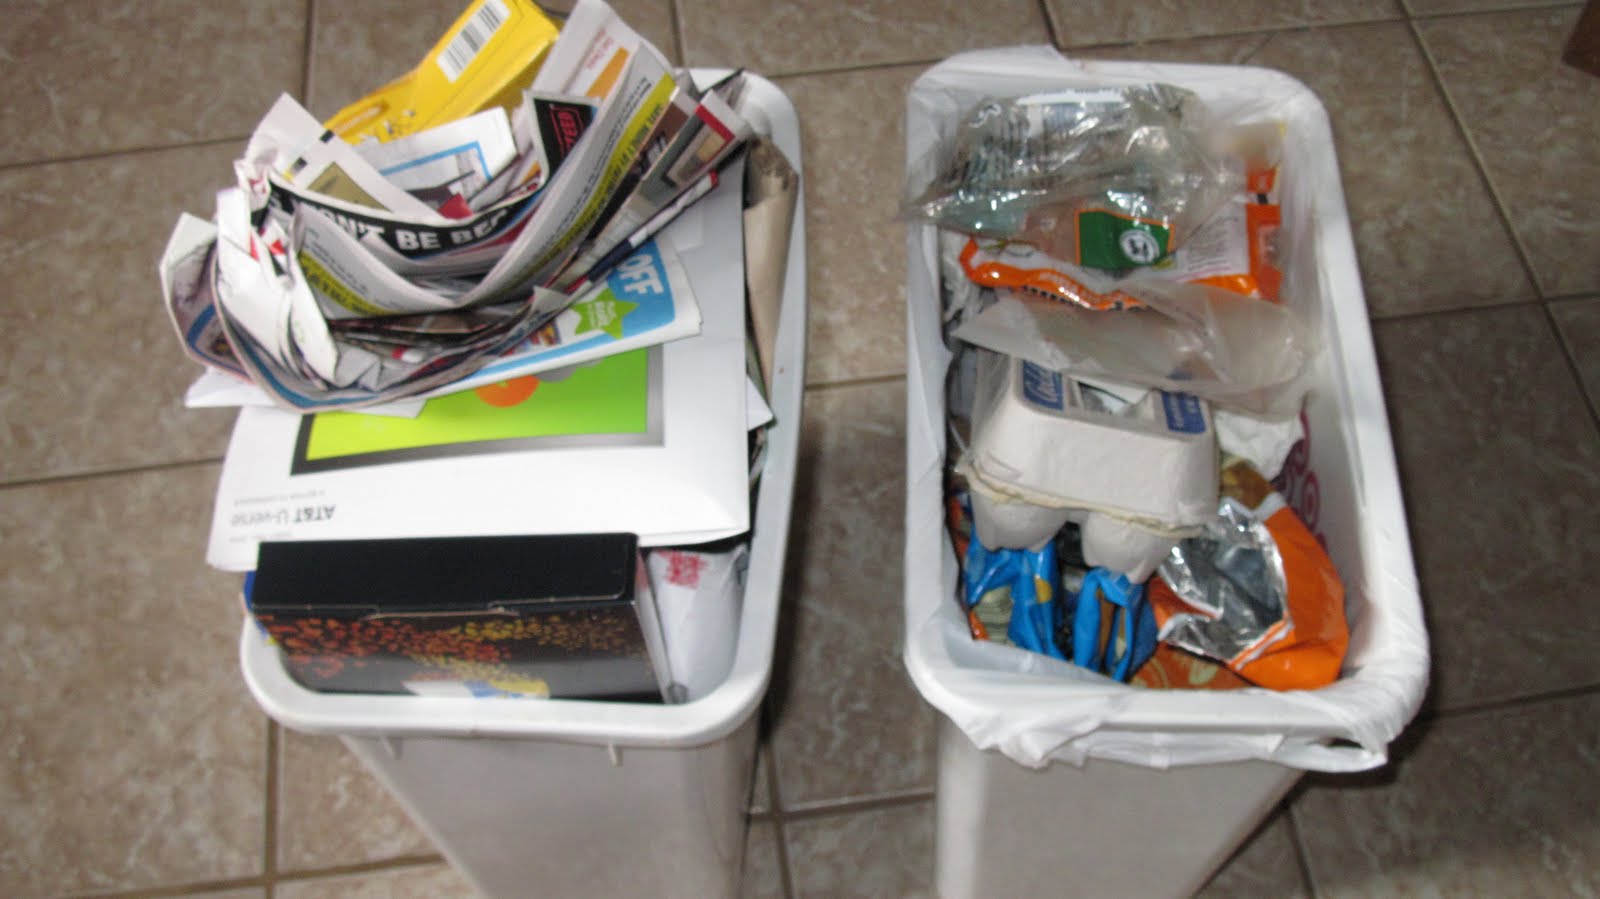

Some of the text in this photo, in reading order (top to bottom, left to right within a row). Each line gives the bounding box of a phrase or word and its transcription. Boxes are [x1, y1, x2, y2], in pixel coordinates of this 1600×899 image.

[395, 228, 442, 251] BE
[617, 253, 665, 295] OFF
[292, 504, 336, 523] AT&T
